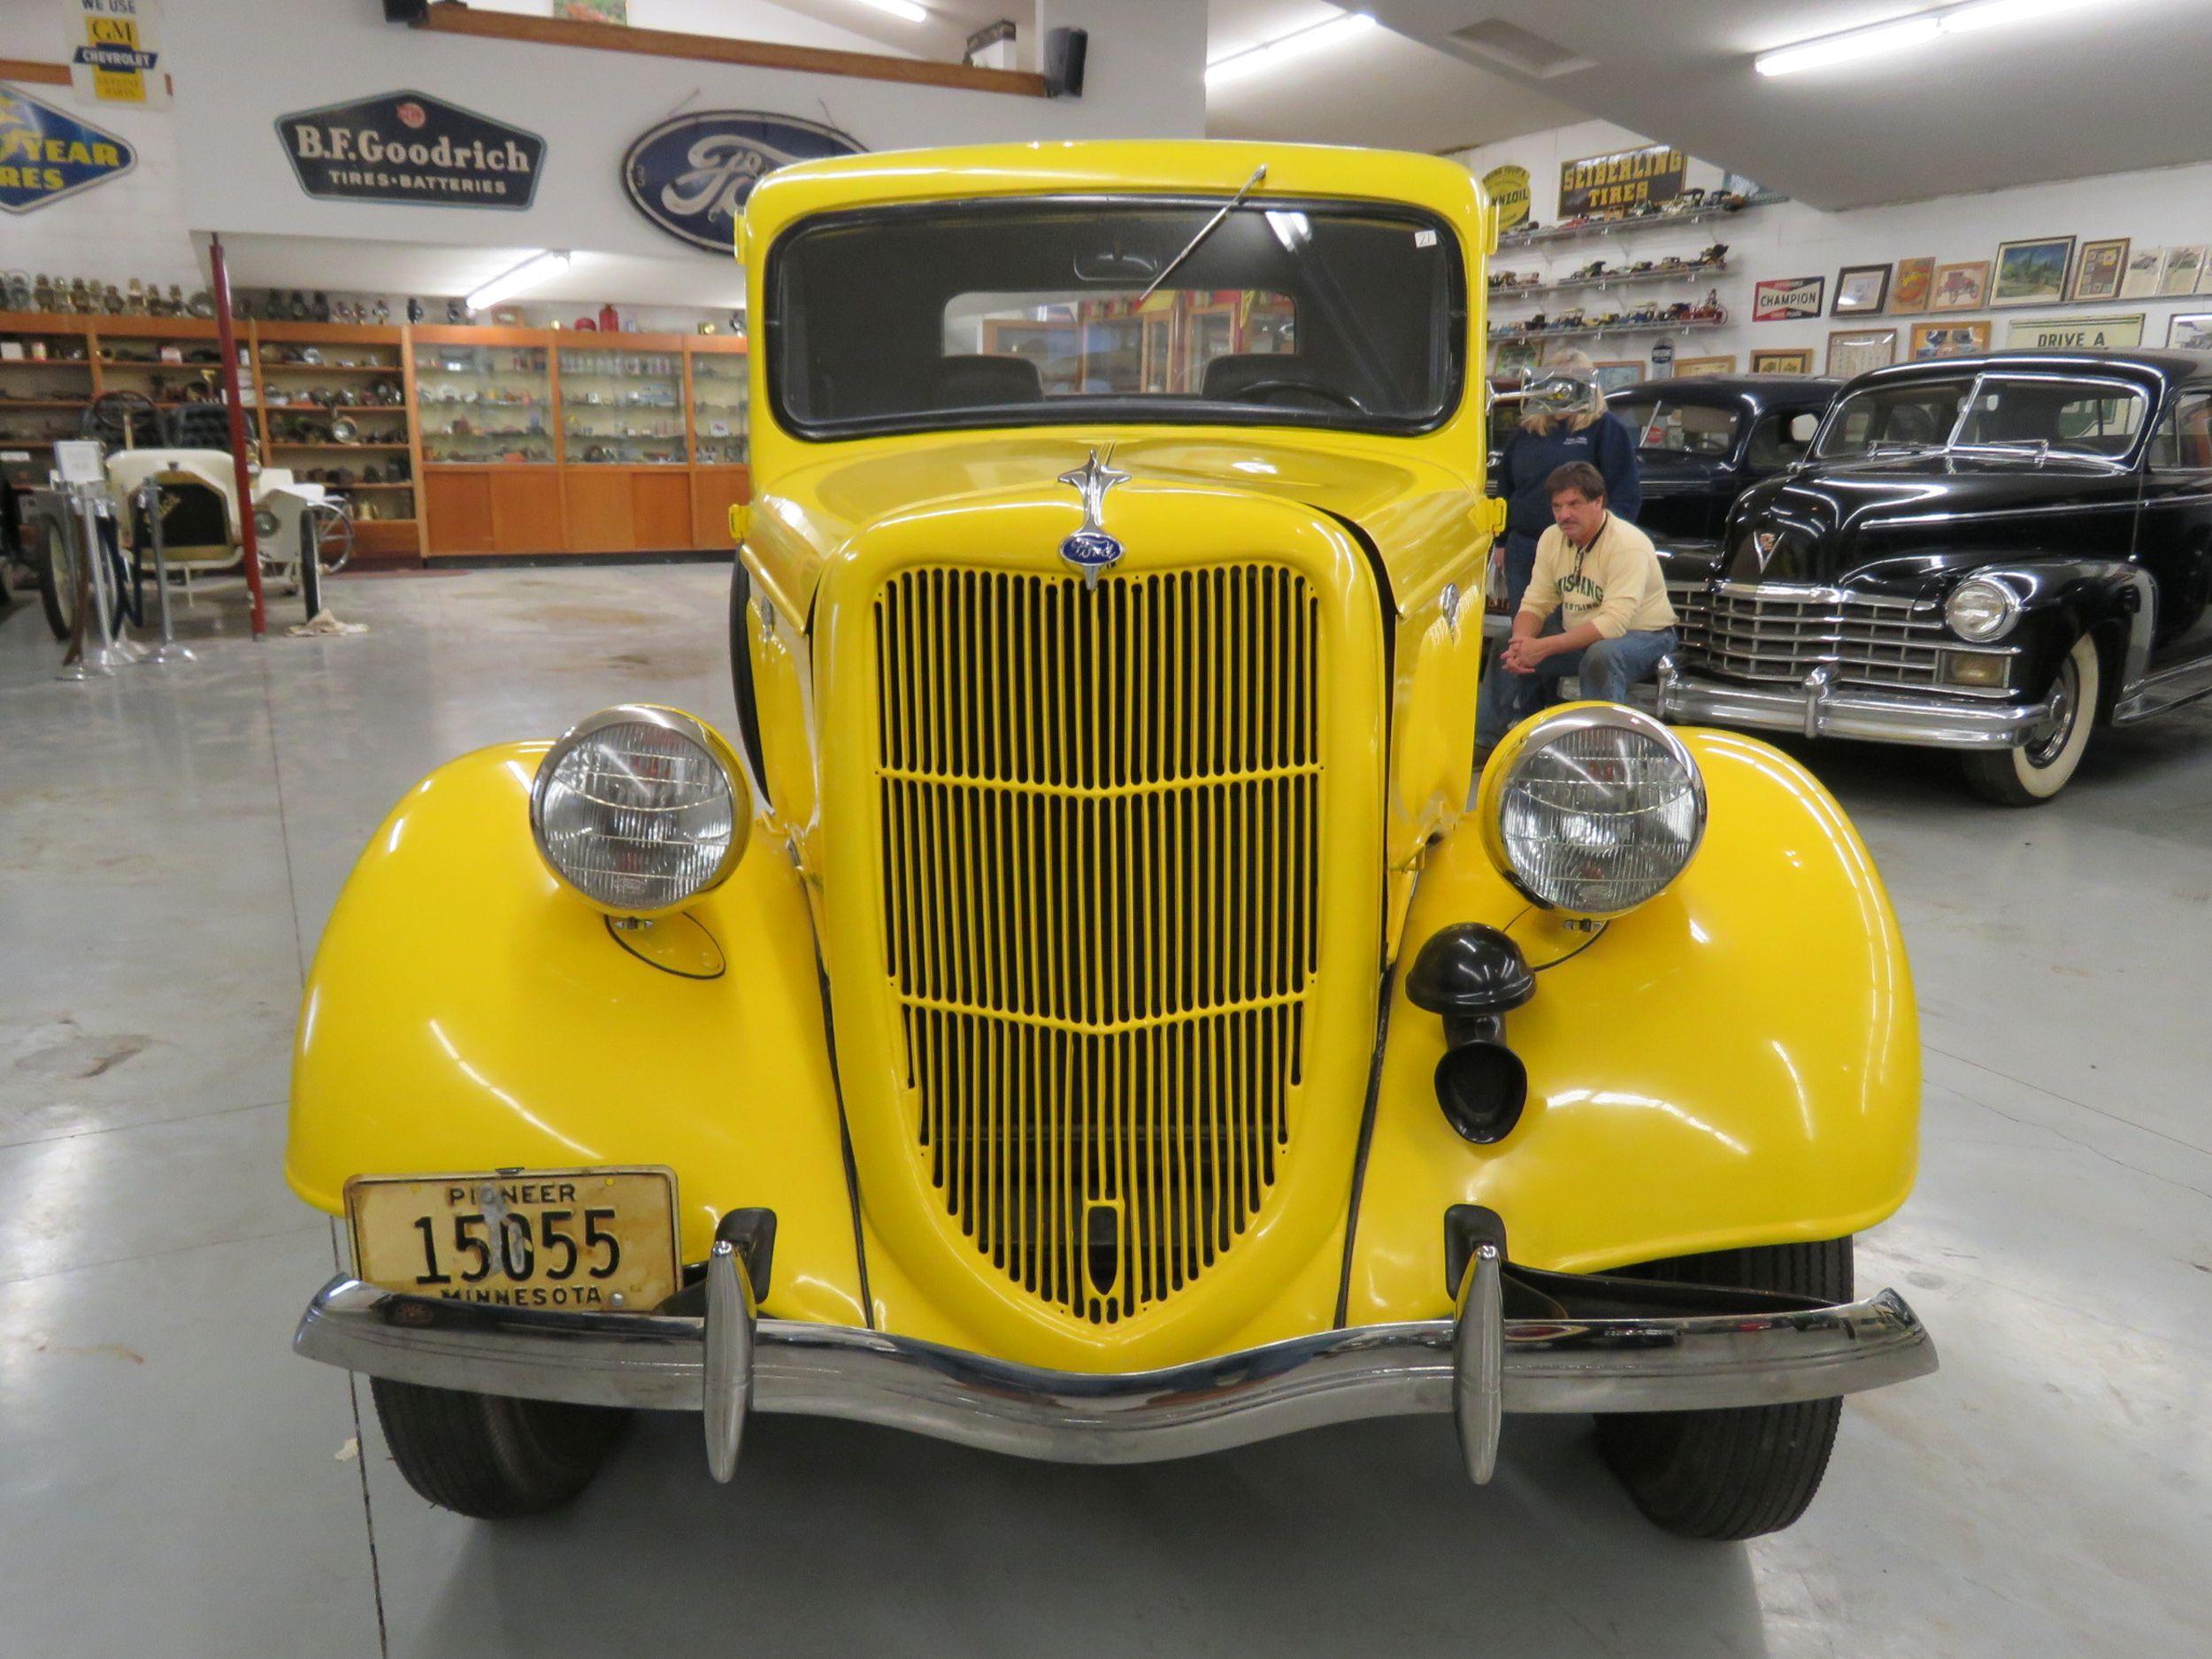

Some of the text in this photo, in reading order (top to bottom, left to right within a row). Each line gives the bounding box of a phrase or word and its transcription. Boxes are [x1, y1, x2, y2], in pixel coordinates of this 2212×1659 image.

[92, 19, 132, 41] GM
[82, 49, 150, 68] CHEVROLET
[23, 138, 119, 166] YEAR
[0, 165, 65, 190] RES
[1563, 150, 1682, 192] SEIBERLING
[1588, 180, 1648, 208] TIRES
[1760, 292, 1816, 308] CHAMPION
[2038, 332, 2105, 347] DRIVE A
[449, 1183, 577, 1206] PINEER
[413, 1209, 620, 1284] 15055
[440, 1286, 602, 1307] MINNESOTA
